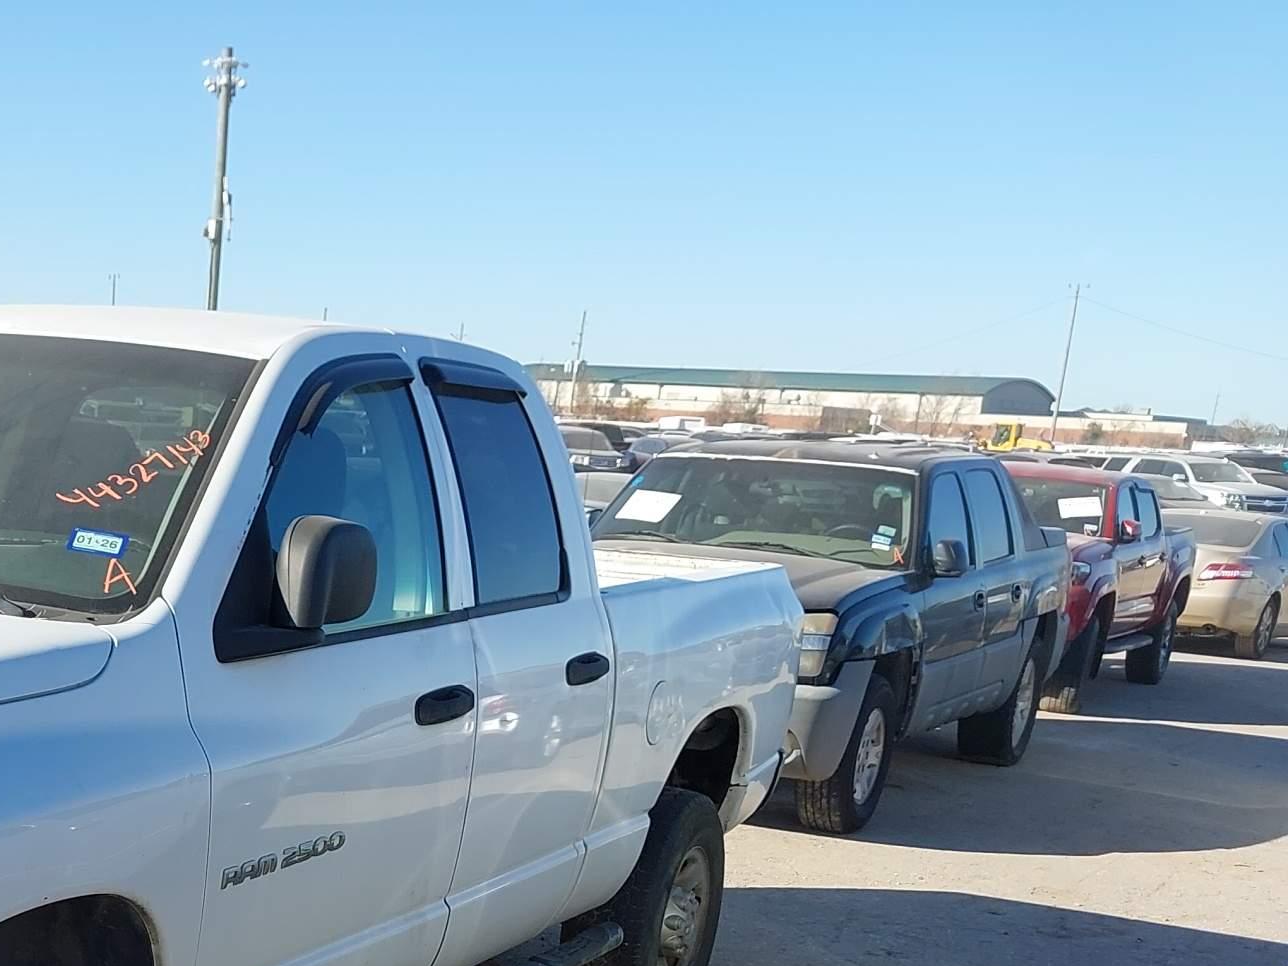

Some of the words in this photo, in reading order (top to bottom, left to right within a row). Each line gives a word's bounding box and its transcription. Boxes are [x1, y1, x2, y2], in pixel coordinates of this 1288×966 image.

[55, 430, 210, 508] 44327143
[104, 558, 137, 595] A
[220, 852, 278, 890] RAM
[280, 831, 346, 869] 2500
